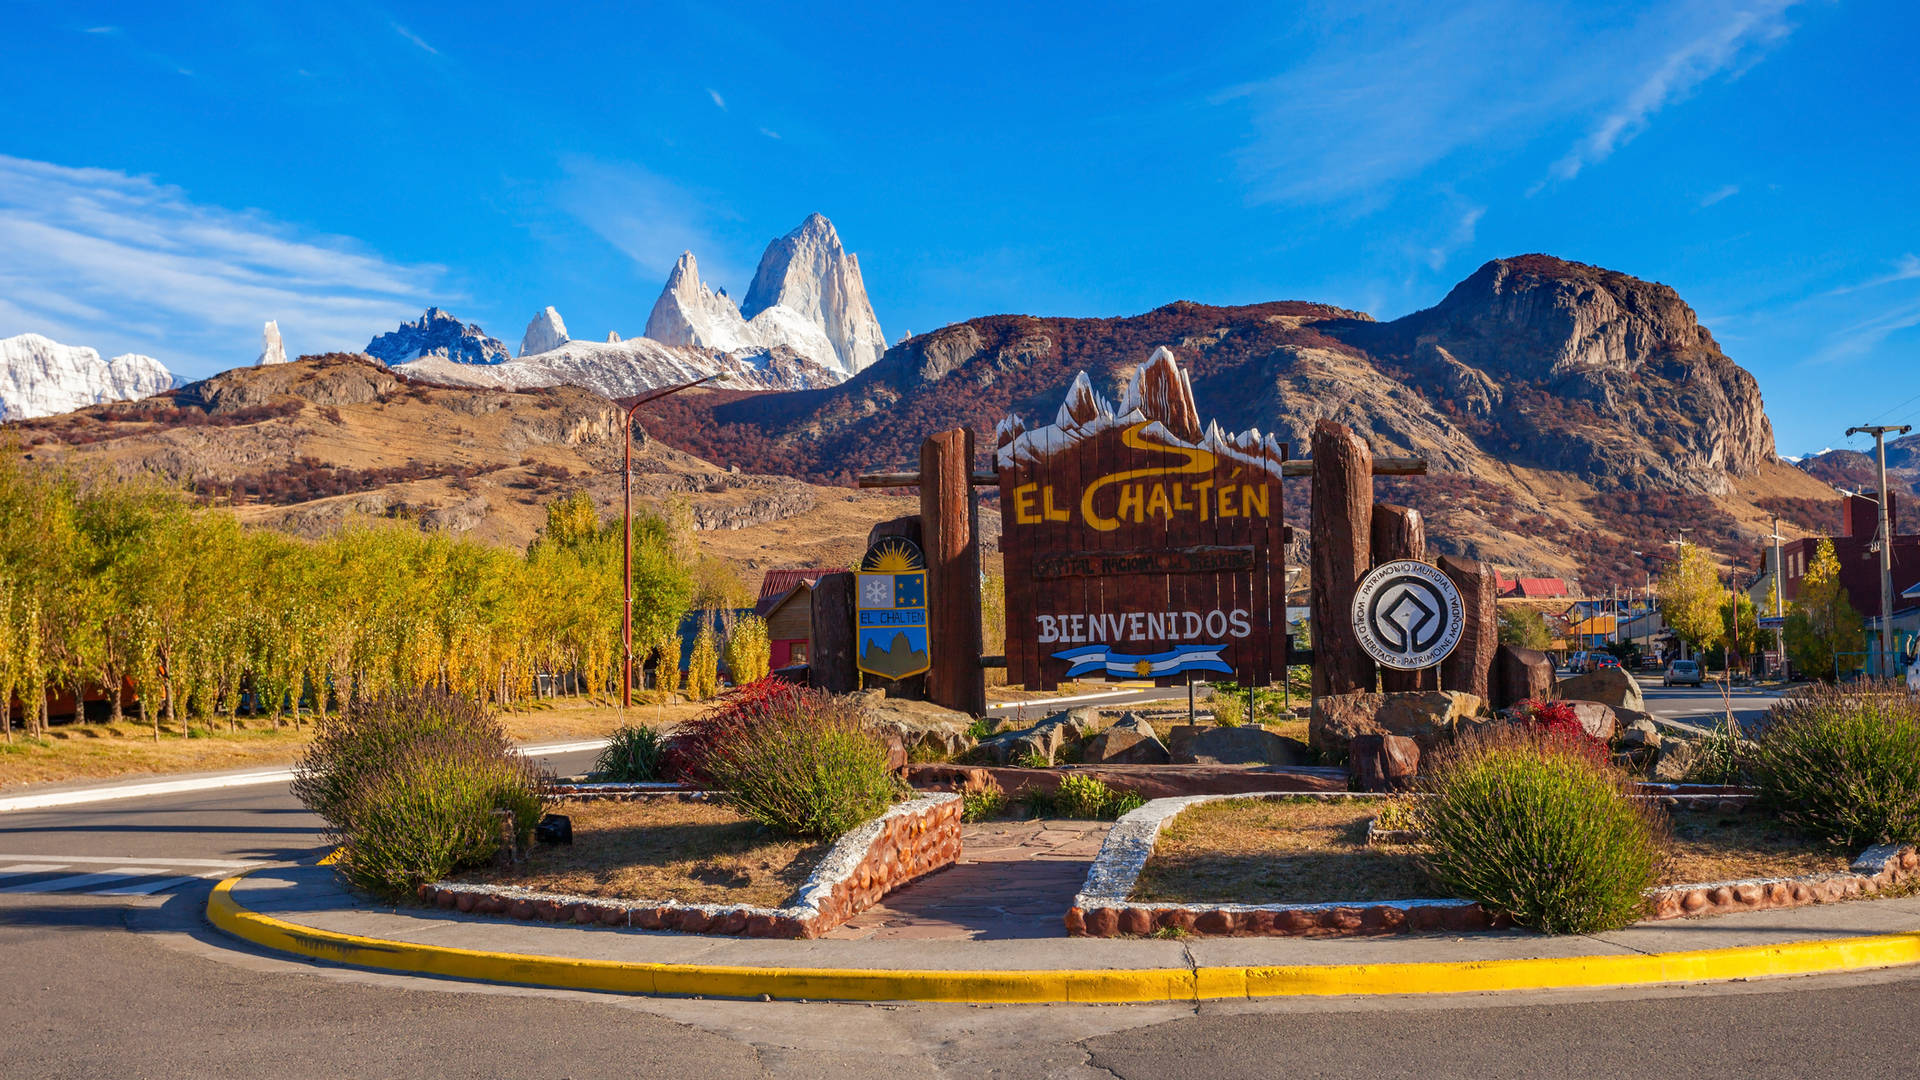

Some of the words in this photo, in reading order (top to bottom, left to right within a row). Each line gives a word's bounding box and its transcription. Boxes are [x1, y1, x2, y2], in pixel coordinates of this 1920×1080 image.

[1013, 482, 1070, 524] EL
[1081, 461, 1270, 531] CHALTÉN
[1363, 564, 1411, 595] PATRIMONIO
[1414, 565, 1449, 592] MUNDIAL
[861, 613, 873, 625] EL
[880, 612, 924, 624] CHALTEN
[1037, 609, 1251, 643] BIENVENIDOS
[1357, 601, 1367, 634] WORLD
[1362, 635, 1396, 664] HERITAGE
[1404, 640, 1451, 665] PATRIMOINE
[1450, 594, 1460, 638] MONDIAL
